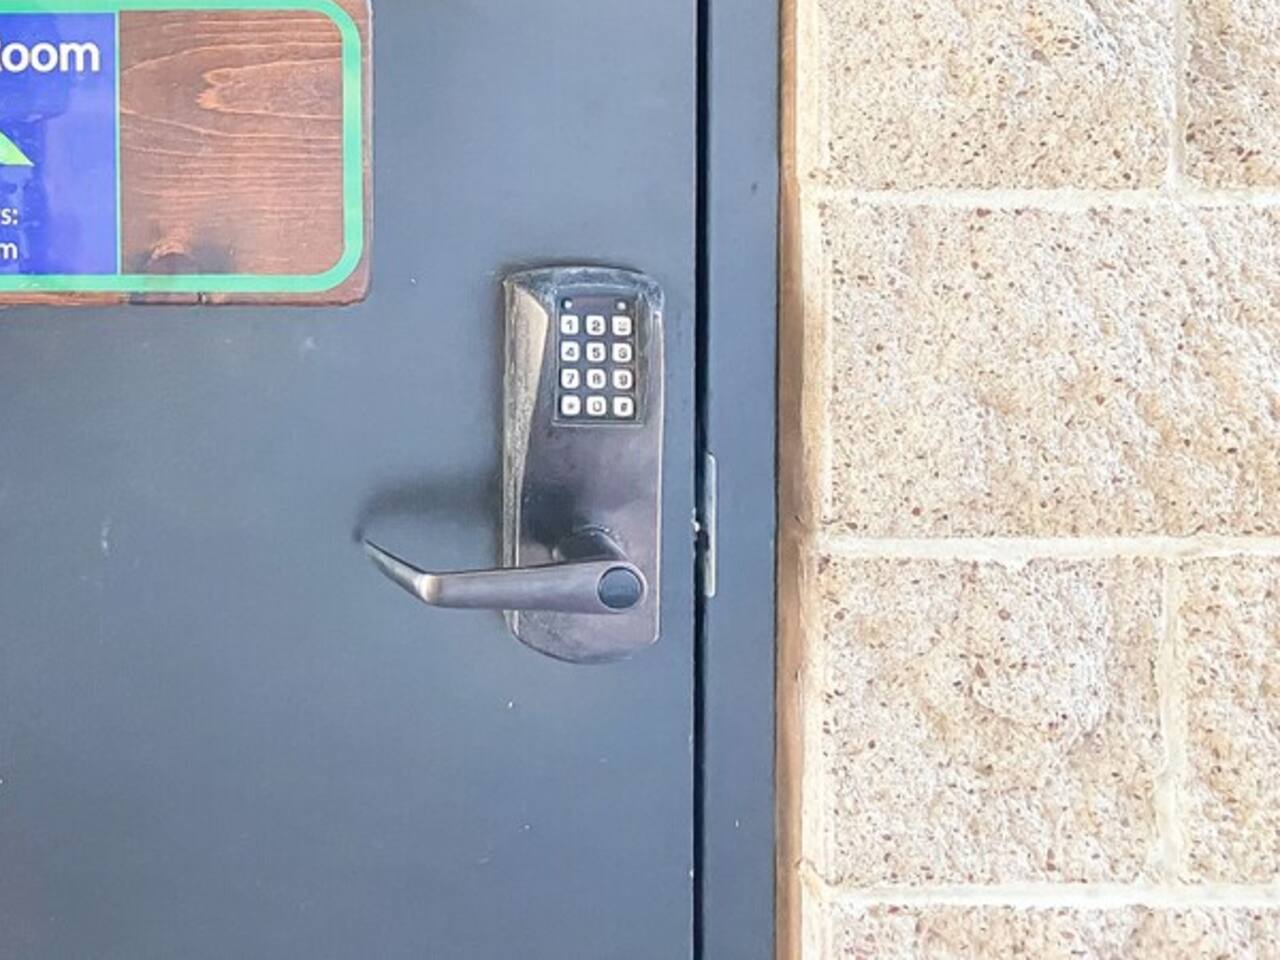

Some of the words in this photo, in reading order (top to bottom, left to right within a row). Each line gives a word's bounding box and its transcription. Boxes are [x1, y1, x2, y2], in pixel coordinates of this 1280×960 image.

[591, 319, 601, 333] 2
[564, 346, 576, 358] 4
[591, 346, 601, 360] 5
[565, 372, 575, 385] 7
[618, 373, 628, 387] 9
